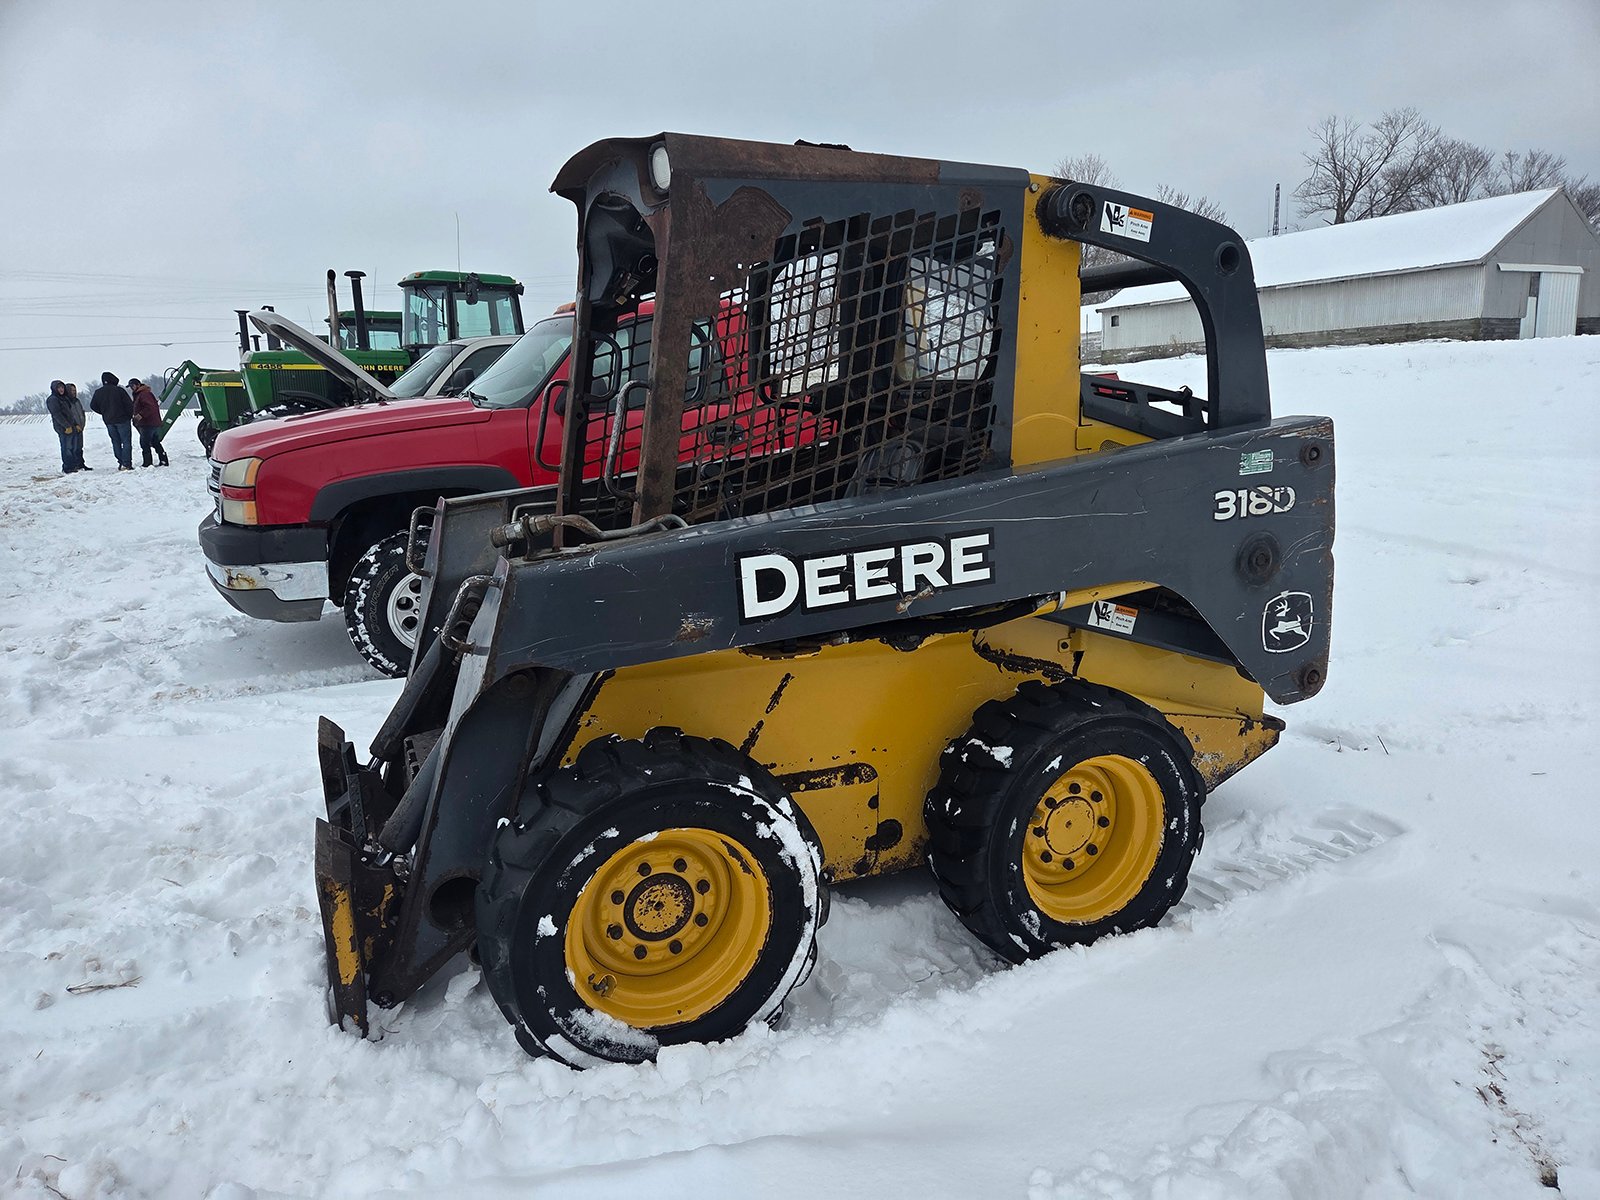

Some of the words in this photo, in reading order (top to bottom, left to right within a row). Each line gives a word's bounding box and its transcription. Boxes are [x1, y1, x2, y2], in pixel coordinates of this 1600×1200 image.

[1134, 211, 1151, 220] WARNING
[1214, 486, 1296, 521] 318D
[740, 533, 991, 619] DEERE
